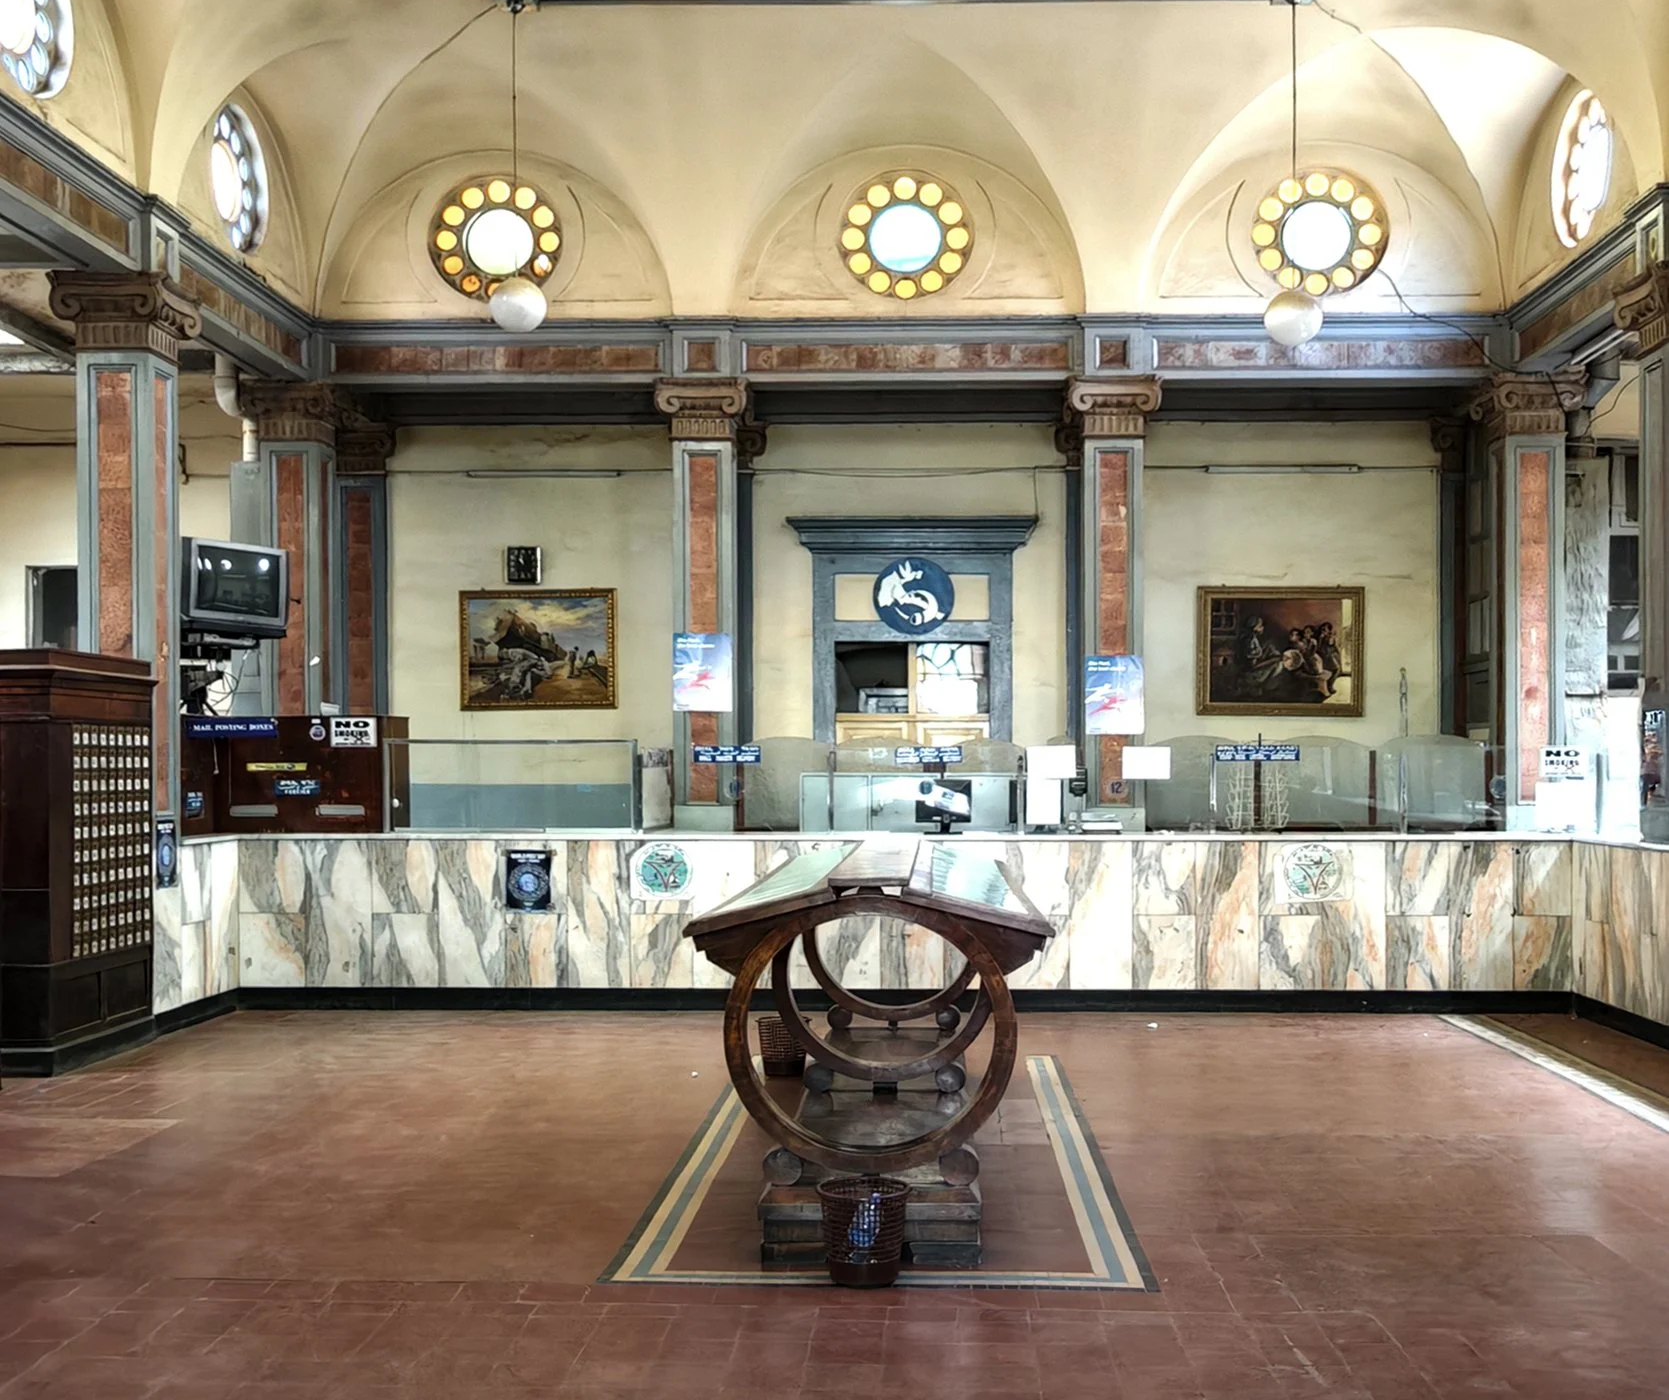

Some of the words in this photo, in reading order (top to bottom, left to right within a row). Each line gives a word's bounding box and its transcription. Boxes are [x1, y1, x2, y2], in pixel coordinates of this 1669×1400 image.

[335, 721, 370, 729] NO
[334, 730, 369, 738] SMOKING
[1111, 781, 1123, 794] 12
